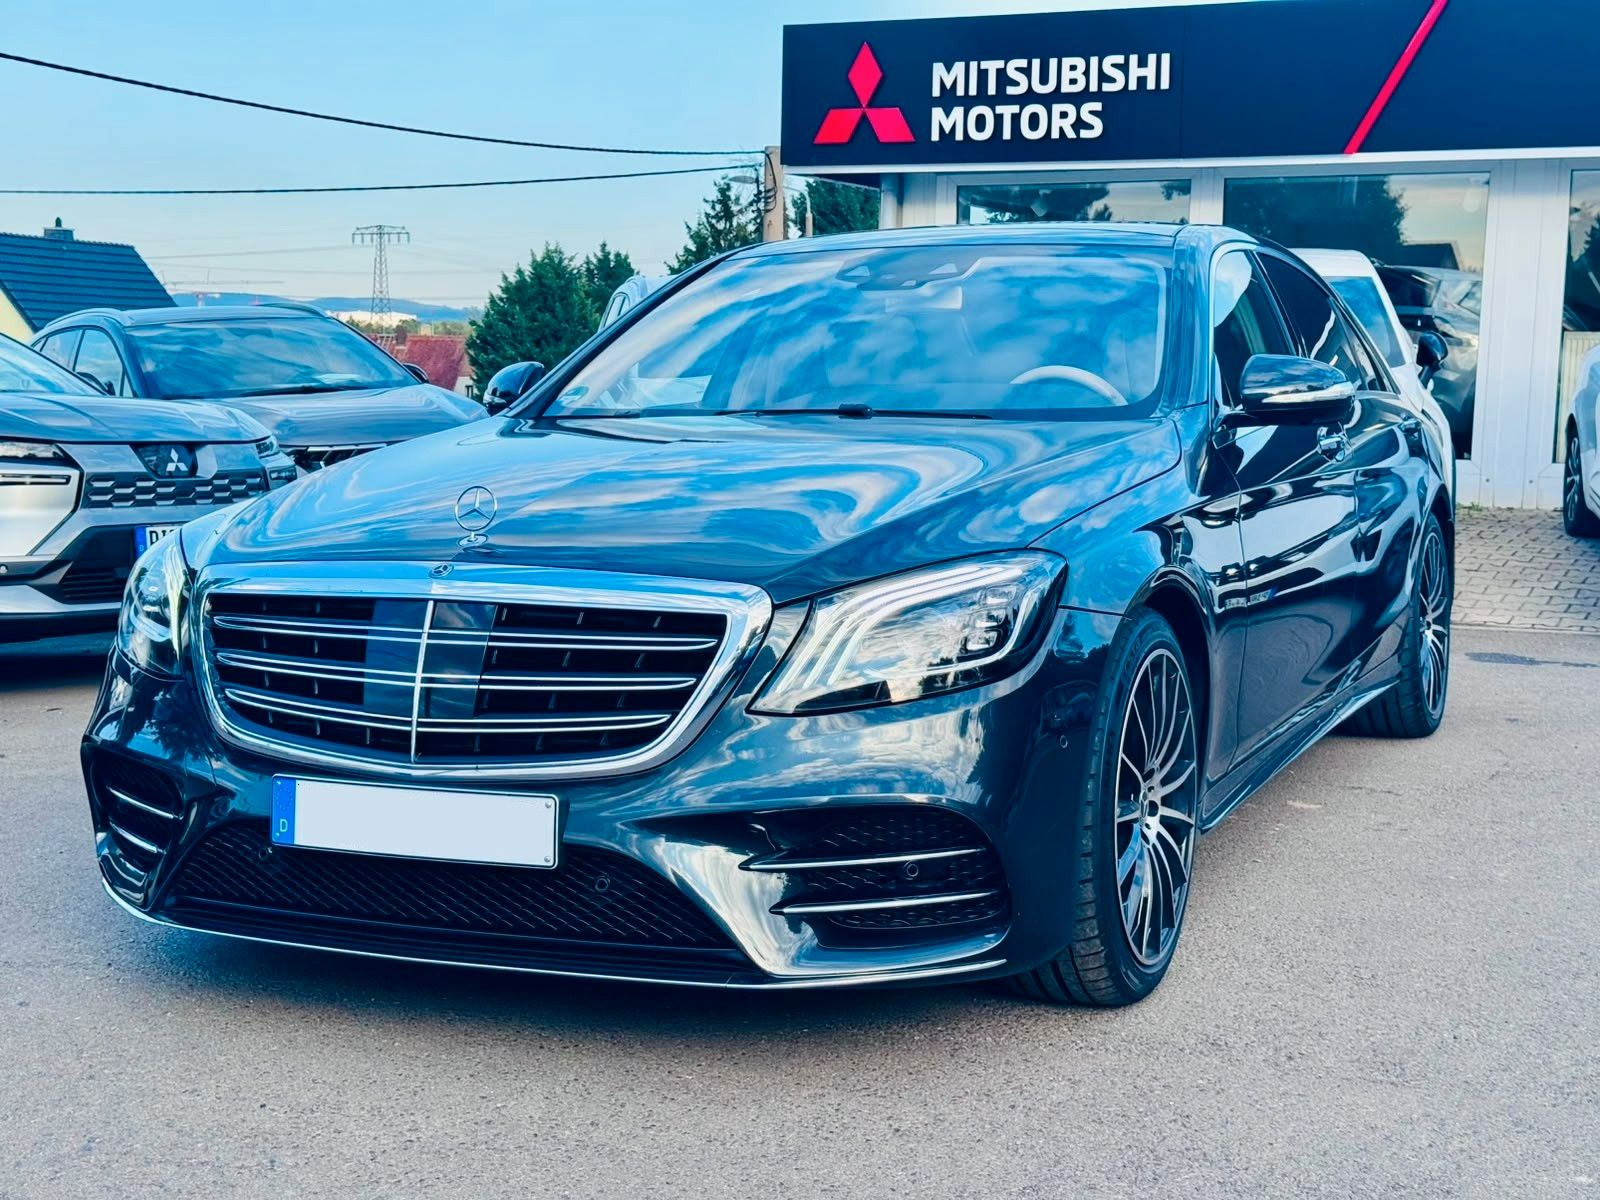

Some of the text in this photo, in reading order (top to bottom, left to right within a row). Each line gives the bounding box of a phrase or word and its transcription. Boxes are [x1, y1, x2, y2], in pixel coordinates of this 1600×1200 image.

[932, 52, 1171, 98] MITSUBISHI
[930, 101, 1104, 142] MOTORS
[280, 818, 288, 832] D
